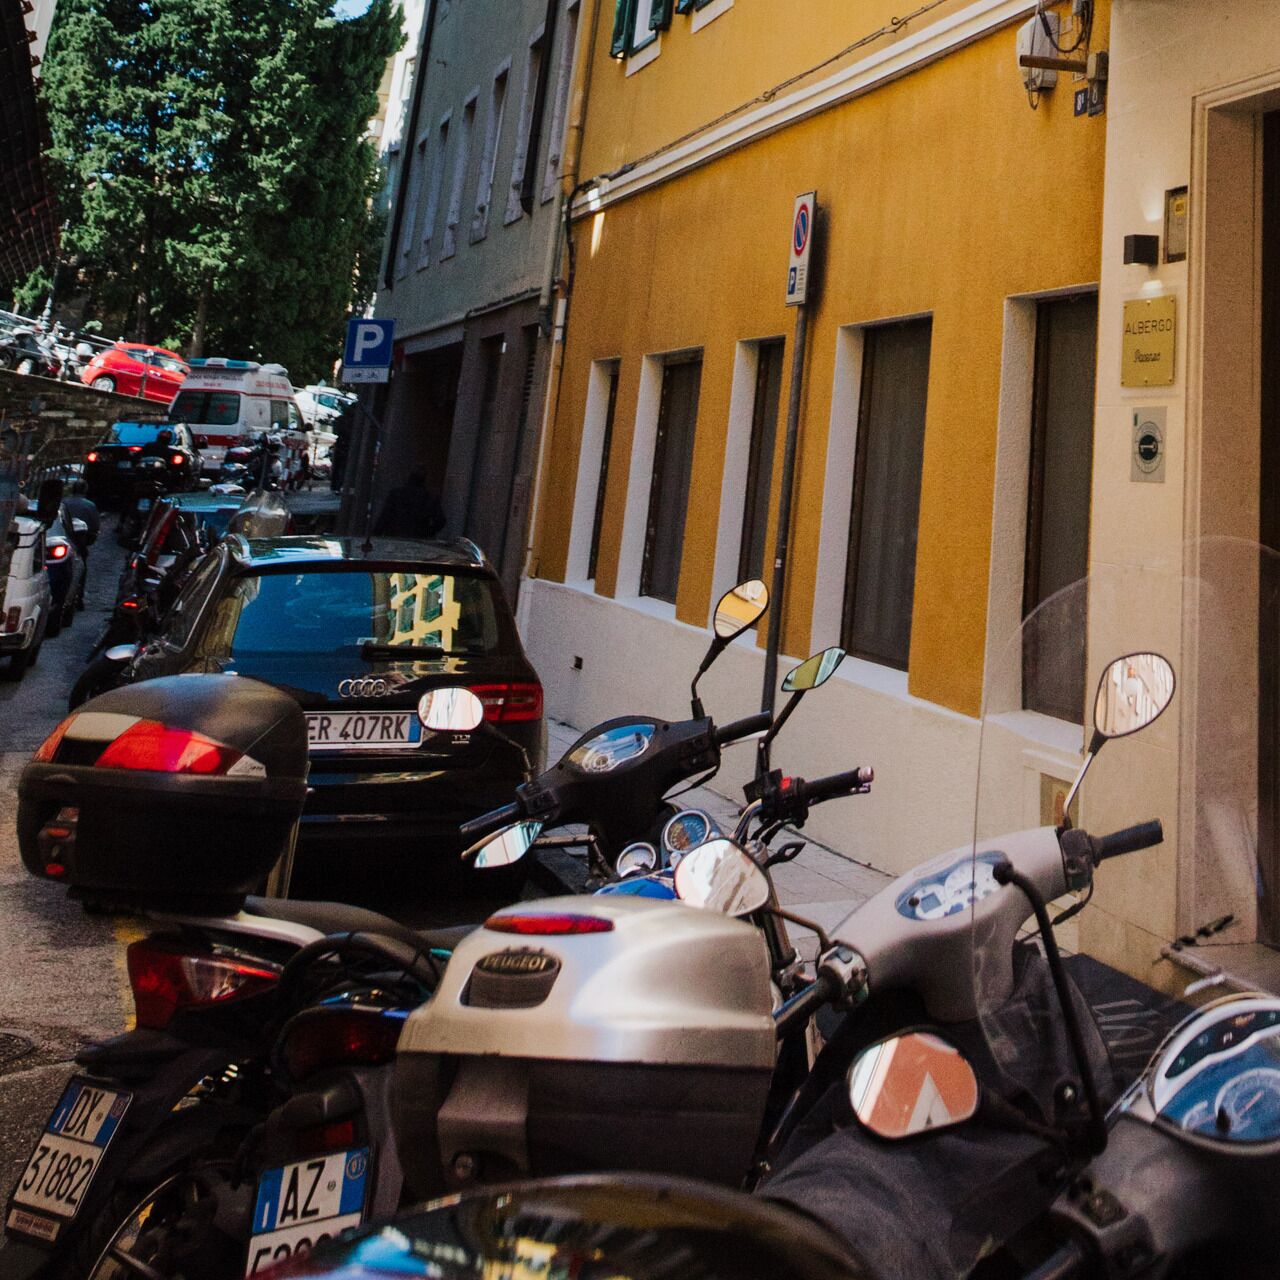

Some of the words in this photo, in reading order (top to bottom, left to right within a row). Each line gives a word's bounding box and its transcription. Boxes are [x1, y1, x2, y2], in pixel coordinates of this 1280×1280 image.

[353, 324, 385, 362] P
[1124, 318, 1173, 336] ALBERGO
[339, 715, 408, 740] 407RK
[483, 954, 547, 970] PEUGEOT
[63, 1089, 105, 1137] DX
[22, 1145, 95, 1205] 31882
[279, 1159, 327, 1225] AZ
